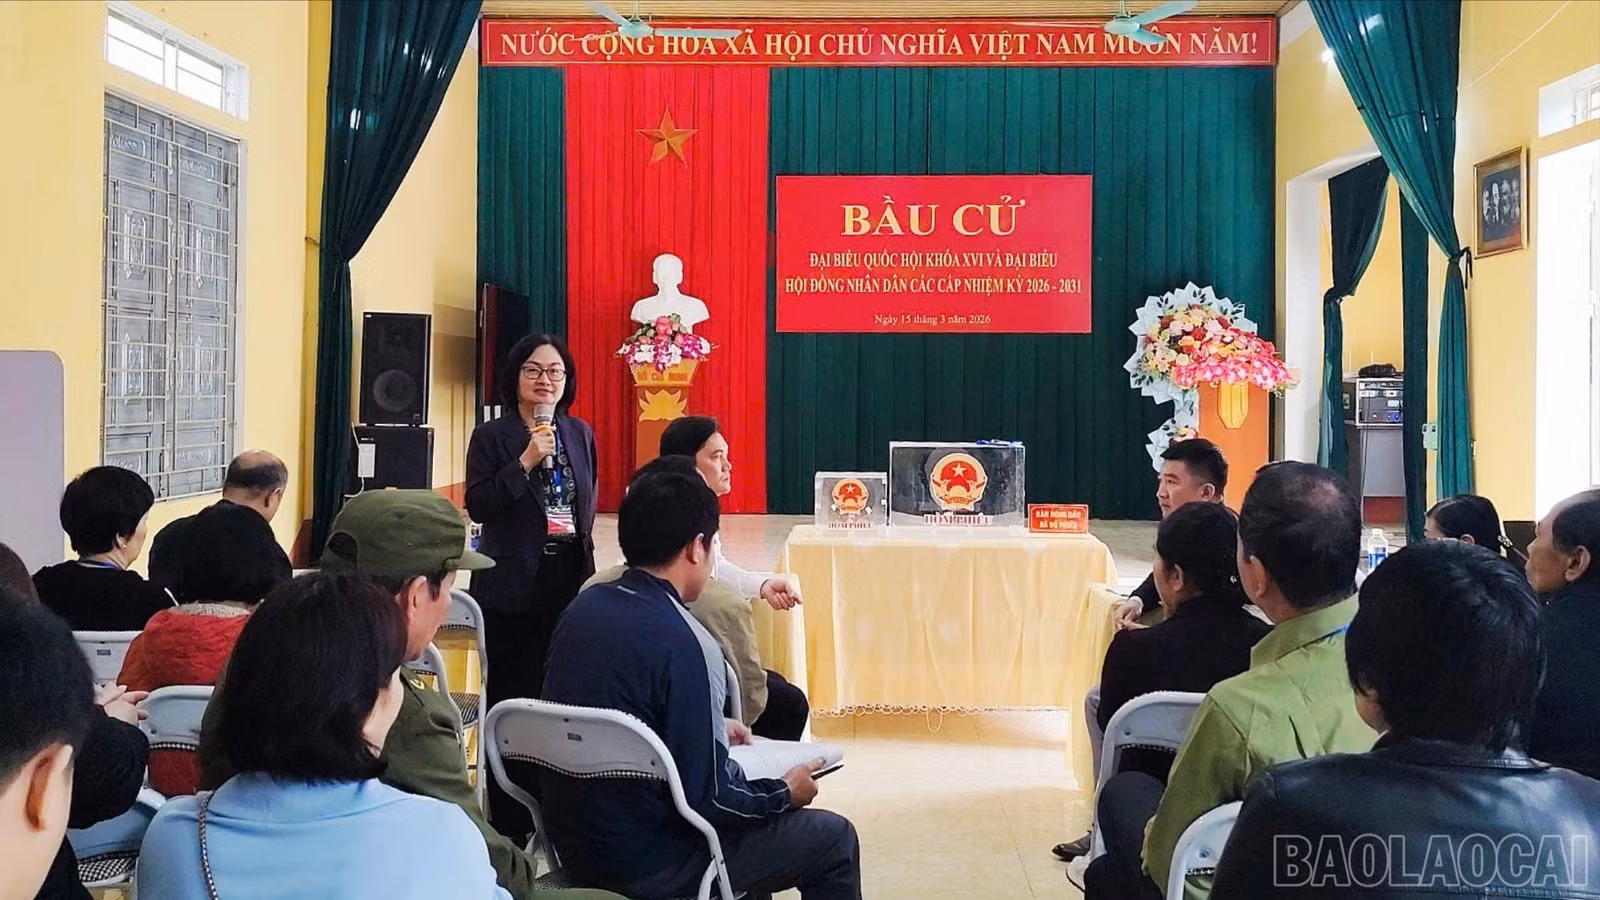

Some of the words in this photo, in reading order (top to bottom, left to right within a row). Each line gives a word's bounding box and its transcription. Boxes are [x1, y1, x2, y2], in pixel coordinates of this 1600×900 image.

[501, 27, 575, 55] NƯỚC
[581, 31, 655, 61] CỘNG
[722, 28, 758, 55] XÃ
[764, 31, 812, 61] HỘI
[819, 27, 873, 56] CHỦ
[880, 28, 963, 55] NGHĨA
[969, 30, 1030, 61] VIỆT
[1036, 32, 1096, 55] NAM
[1103, 26, 1181, 54] MUÔN
[1190, 26, 1257, 54] NĂM!
[841, 195, 939, 236] BẦU
[953, 195, 1026, 236] CỬ
[810, 252, 831, 271] ĐẠI
[833, 248, 861, 267] BIỂU
[863, 248, 898, 270] QUỐC
[901, 250, 923, 271] HỘI
[925, 248, 960, 267] KHÓA
[962, 253, 984, 267] XVI
[986, 248, 1003, 267] VÀ
[1005, 252, 1026, 271] ĐẠI
[1029, 248, 1058, 267] BIỂU
[785, 275, 807, 296] HỘI
[810, 273, 844, 293] ĐỒNG
[847, 273, 880, 293] NHÂN
[883, 273, 907, 293] DÂN
[910, 274, 935, 293] CÁC
[937, 274, 961, 293] CẤP
[964, 276, 1004, 296] NHIỆM
[1006, 274, 1024, 293] KỲ
[1026, 278, 1050, 293] 2026
[1059, 278, 1082, 293] 2031
[875, 314, 898, 326] Ngày
[902, 314, 912, 324] 15
[914, 314, 938, 326] tháng
[940, 314, 946, 324] 3
[948, 314, 967, 324] năm
[969, 314, 991, 324] 2026
